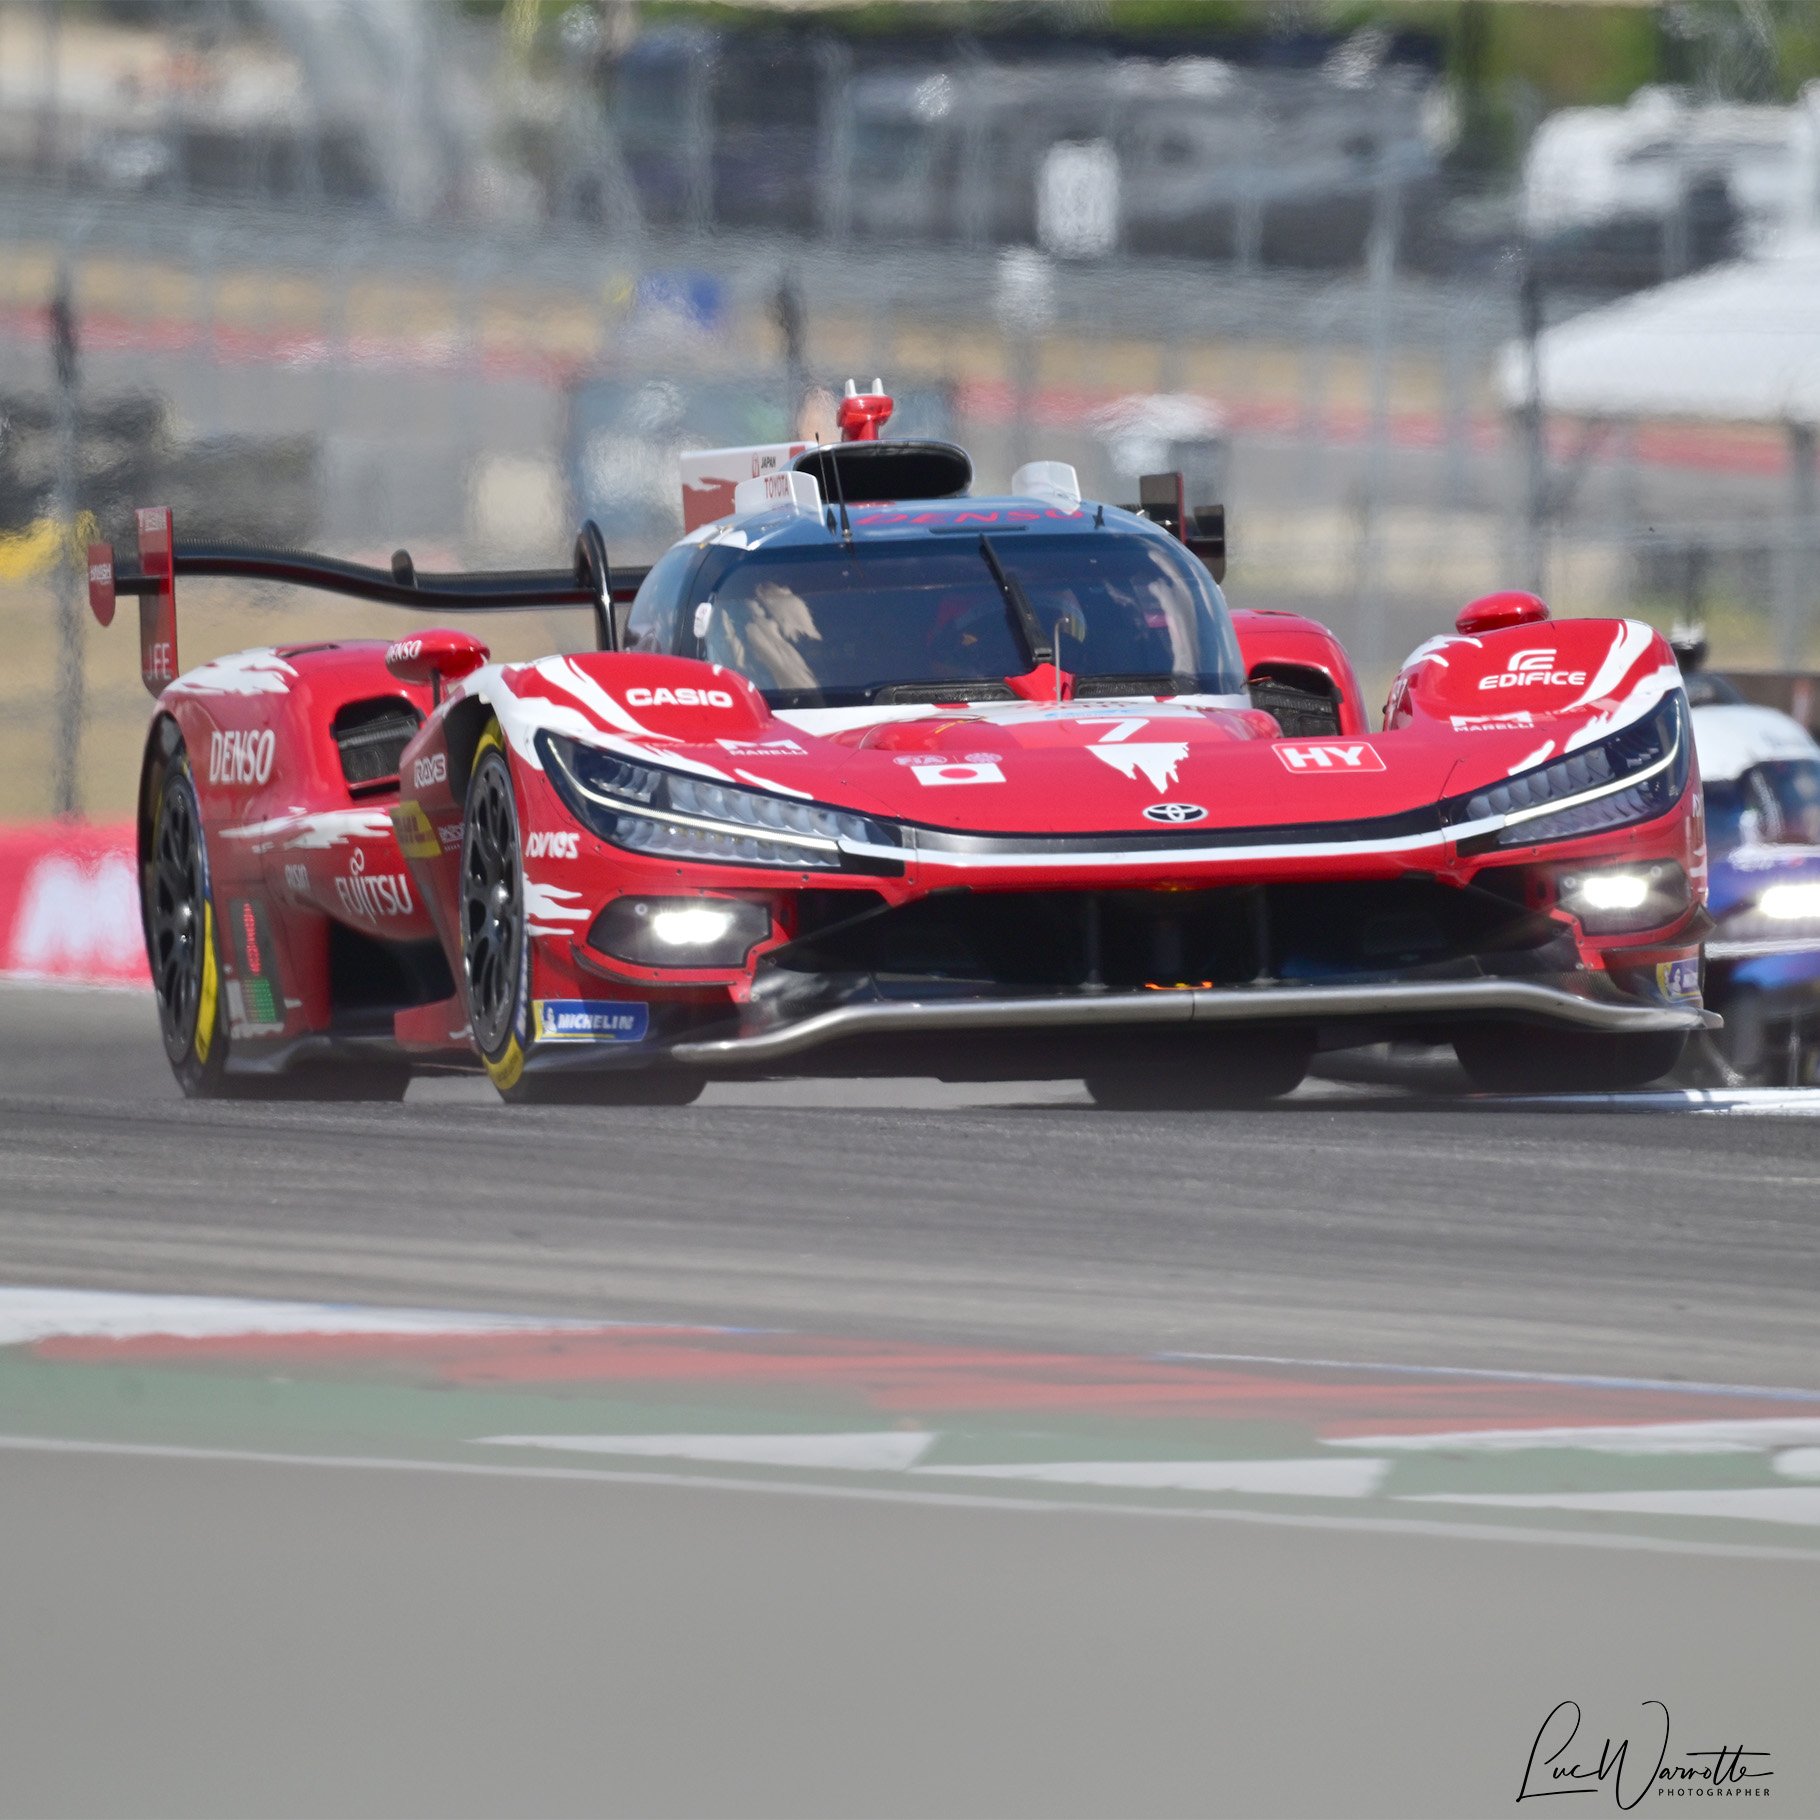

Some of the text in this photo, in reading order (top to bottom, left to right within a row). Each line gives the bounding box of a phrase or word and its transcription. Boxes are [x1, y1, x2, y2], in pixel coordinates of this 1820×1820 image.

[761, 456, 776, 469] JAPAN
[764, 473, 790, 499] TOYOTA
[855, 508, 1084, 526] DENSO
[385, 639, 422, 664] DENSO
[1478, 670, 1587, 690] EDIFICE
[625, 687, 734, 708] CASIO
[1074, 718, 1150, 743] 7
[1453, 722, 1535, 732] MARELLI
[208, 729, 276, 785] DENSO
[1281, 745, 1365, 768] HY
[413, 753, 448, 789] RAYS
[334, 872, 414, 924] FUJITSU
[557, 1013, 635, 1030] MICHELIN
